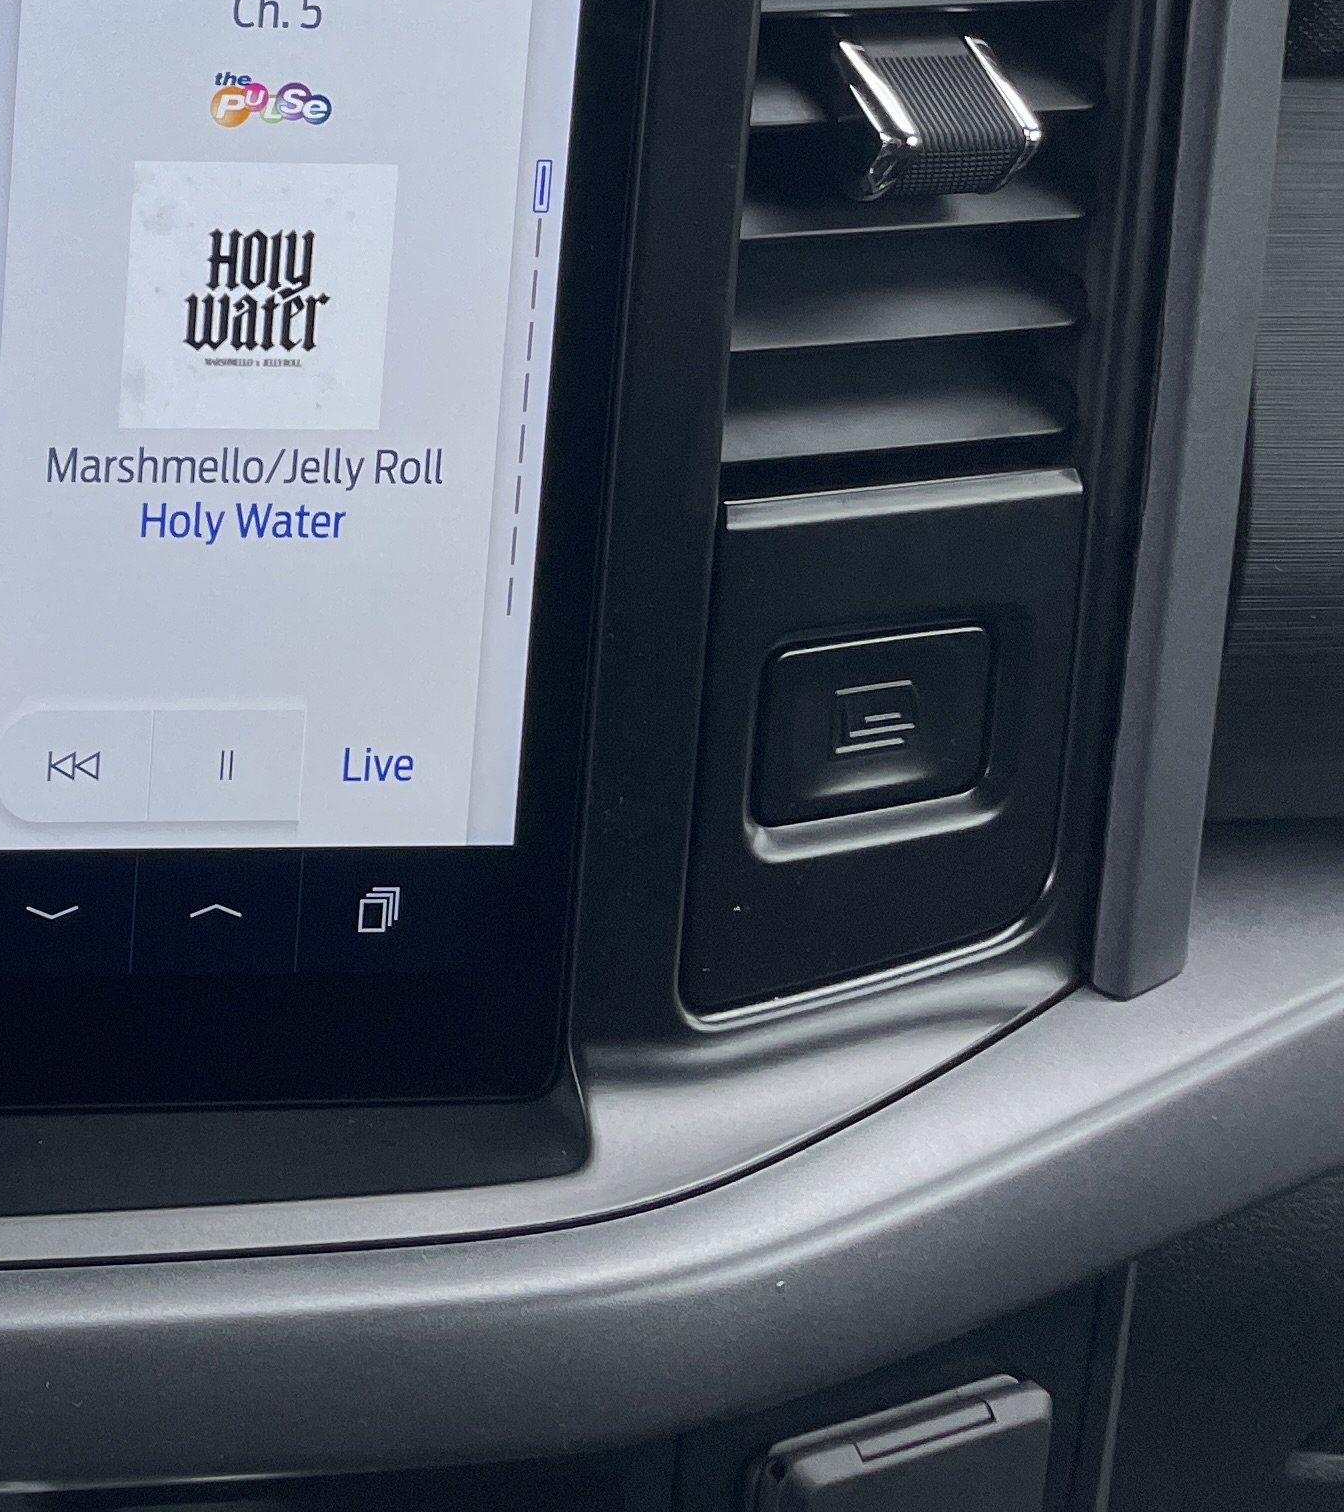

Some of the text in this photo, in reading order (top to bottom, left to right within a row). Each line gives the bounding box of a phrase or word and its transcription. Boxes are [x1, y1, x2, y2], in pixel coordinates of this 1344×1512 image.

[214, 72, 251, 86] the
[47, 446, 443, 492] Marshmello/Jelly Roll
[139, 501, 347, 545] Holy Water
[342, 747, 414, 782] Live
